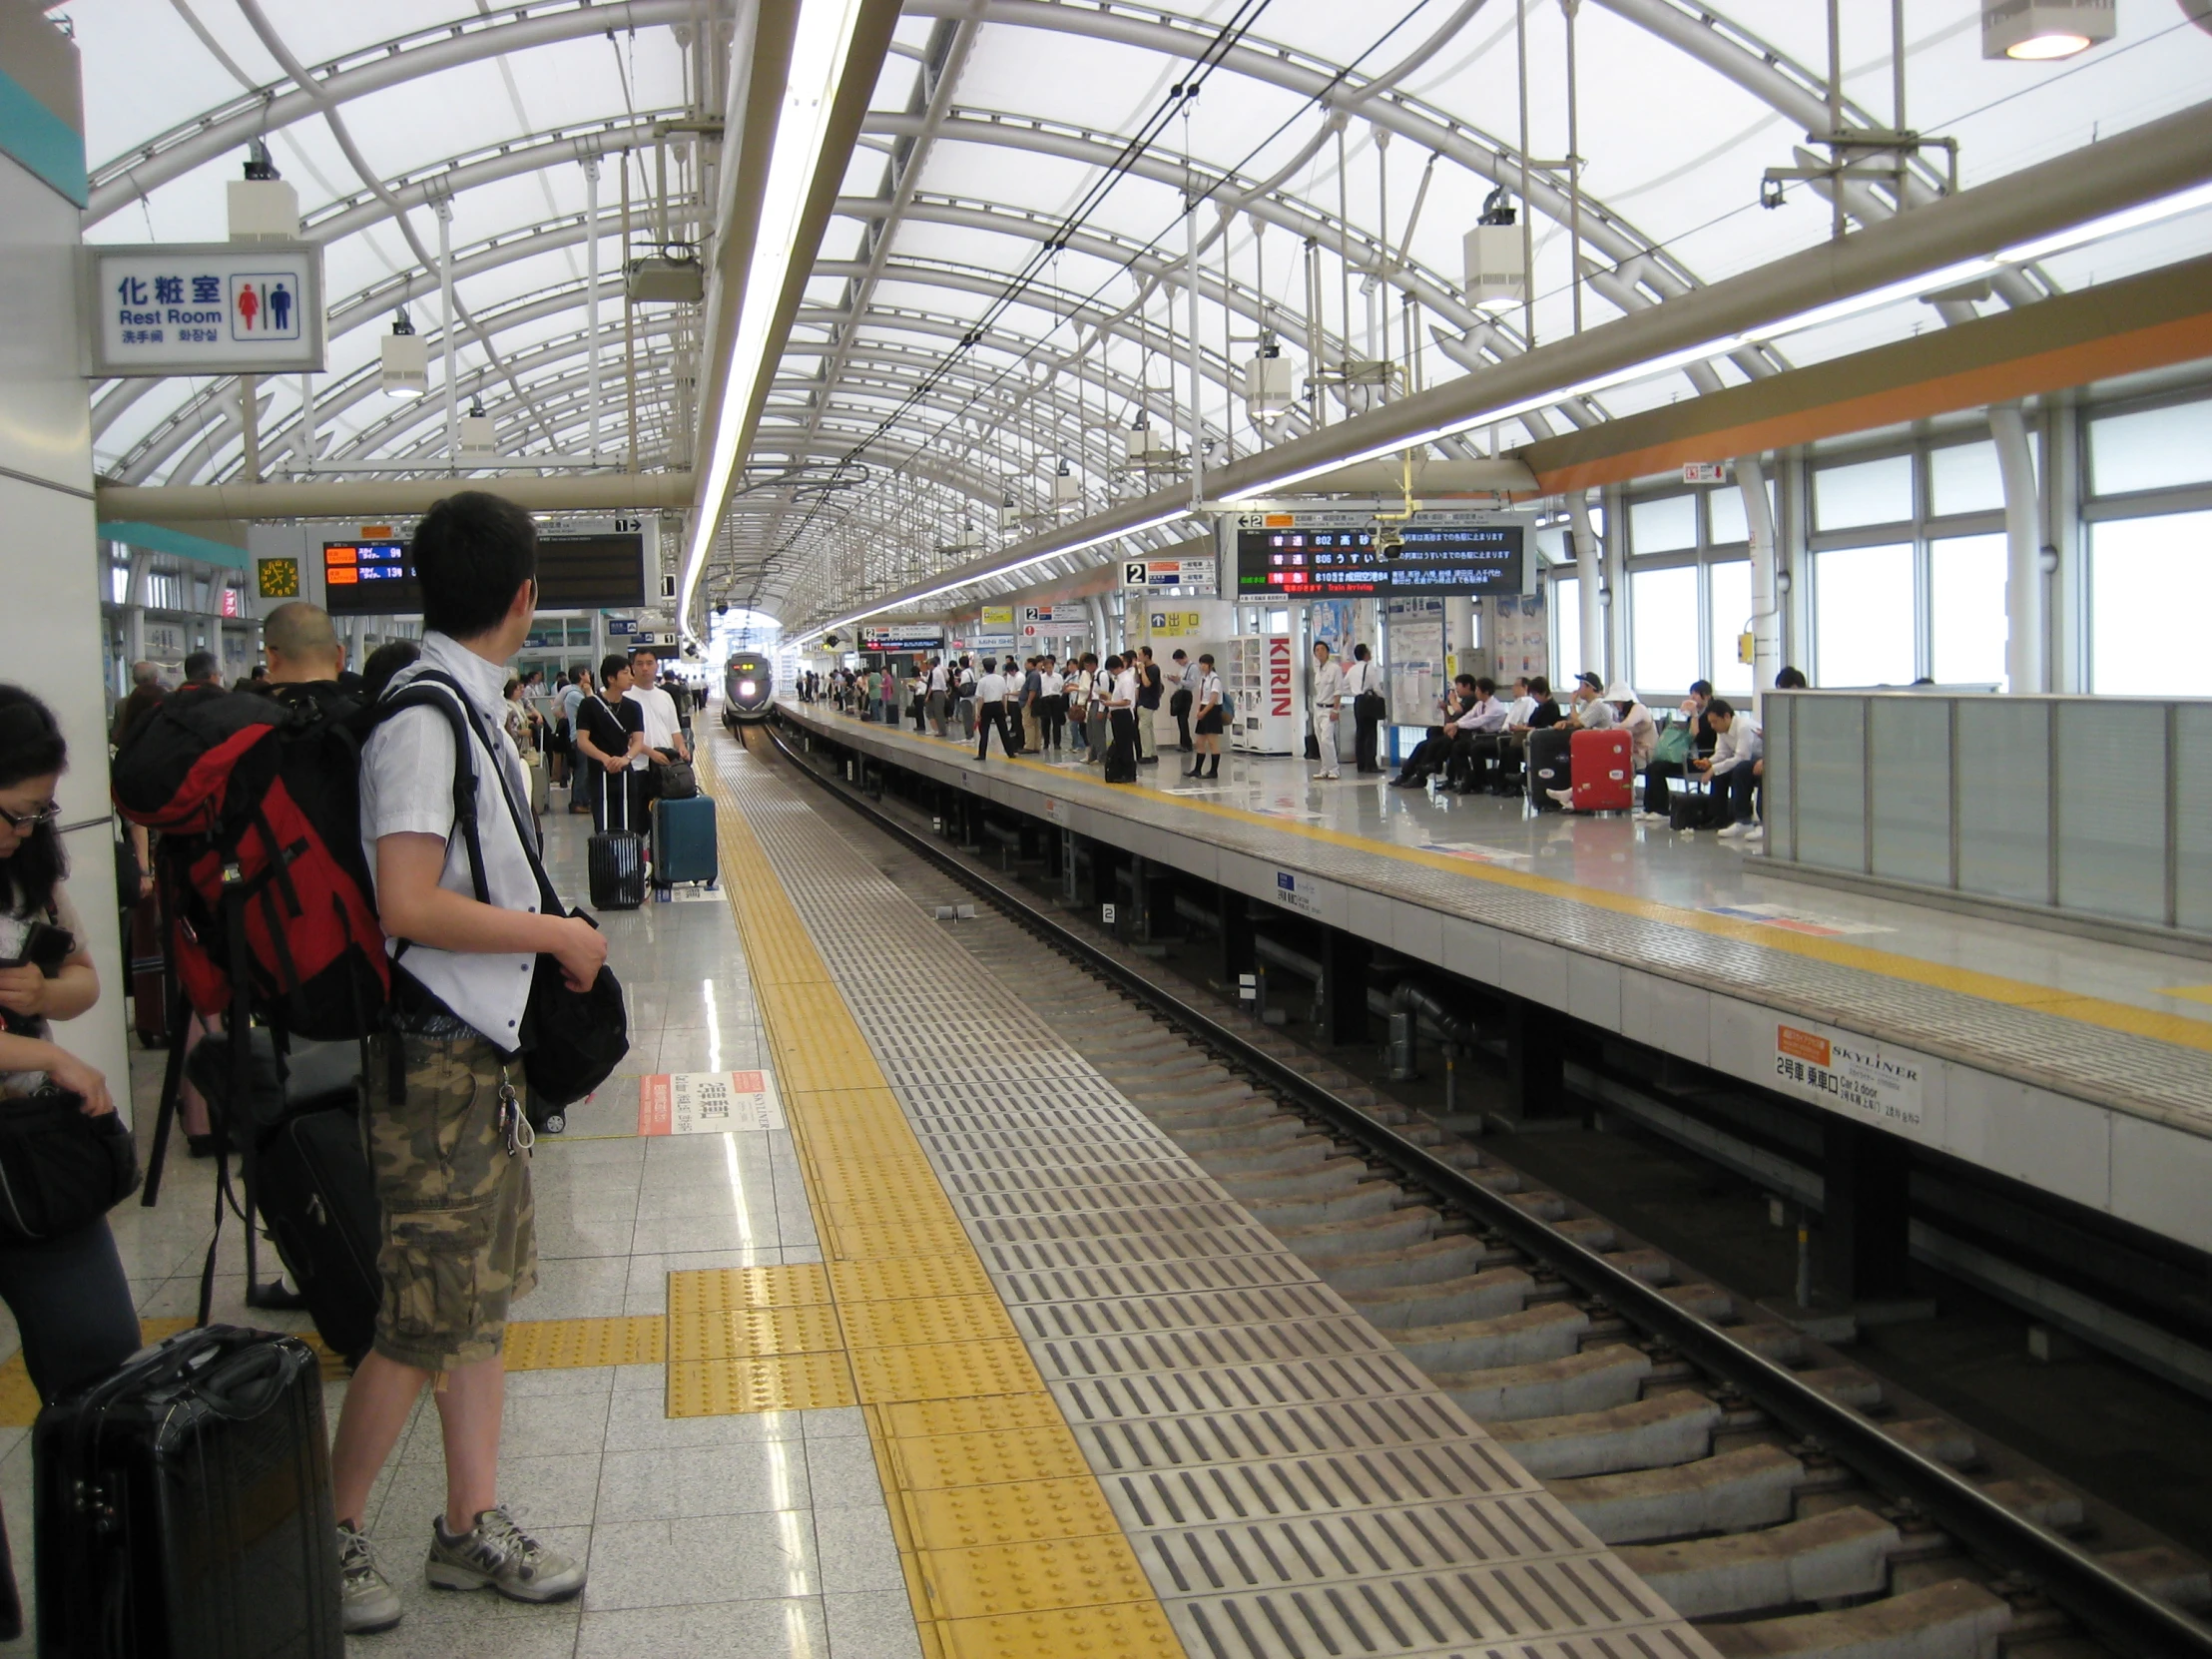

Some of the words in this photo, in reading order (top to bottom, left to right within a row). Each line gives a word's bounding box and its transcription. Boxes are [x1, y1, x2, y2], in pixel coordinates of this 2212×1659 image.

[118, 275, 222, 305] 化粧室
[120, 310, 162, 324] Rest
[168, 309, 223, 323] Room
[178, 328, 218, 342] 화장실
[1340, 534, 1370, 546] 高砂
[1337, 553, 1375, 564] うすい
[1129, 564, 1143, 583] 2
[1273, 572, 1304, 583] 特急
[1028, 608, 1036, 620] 2
[1168, 612, 1199, 627] 出口
[1270, 638, 1292, 717] KIRIN
[1104, 908, 1114, 919] 2
[1776, 1056, 1805, 1082] 2号車
[1807, 1066, 1839, 1095] 乗車口
[1840, 1075, 1854, 1089] Car
[1854, 1080, 1861, 1092] 2
[1860, 1081, 1878, 1098] door
